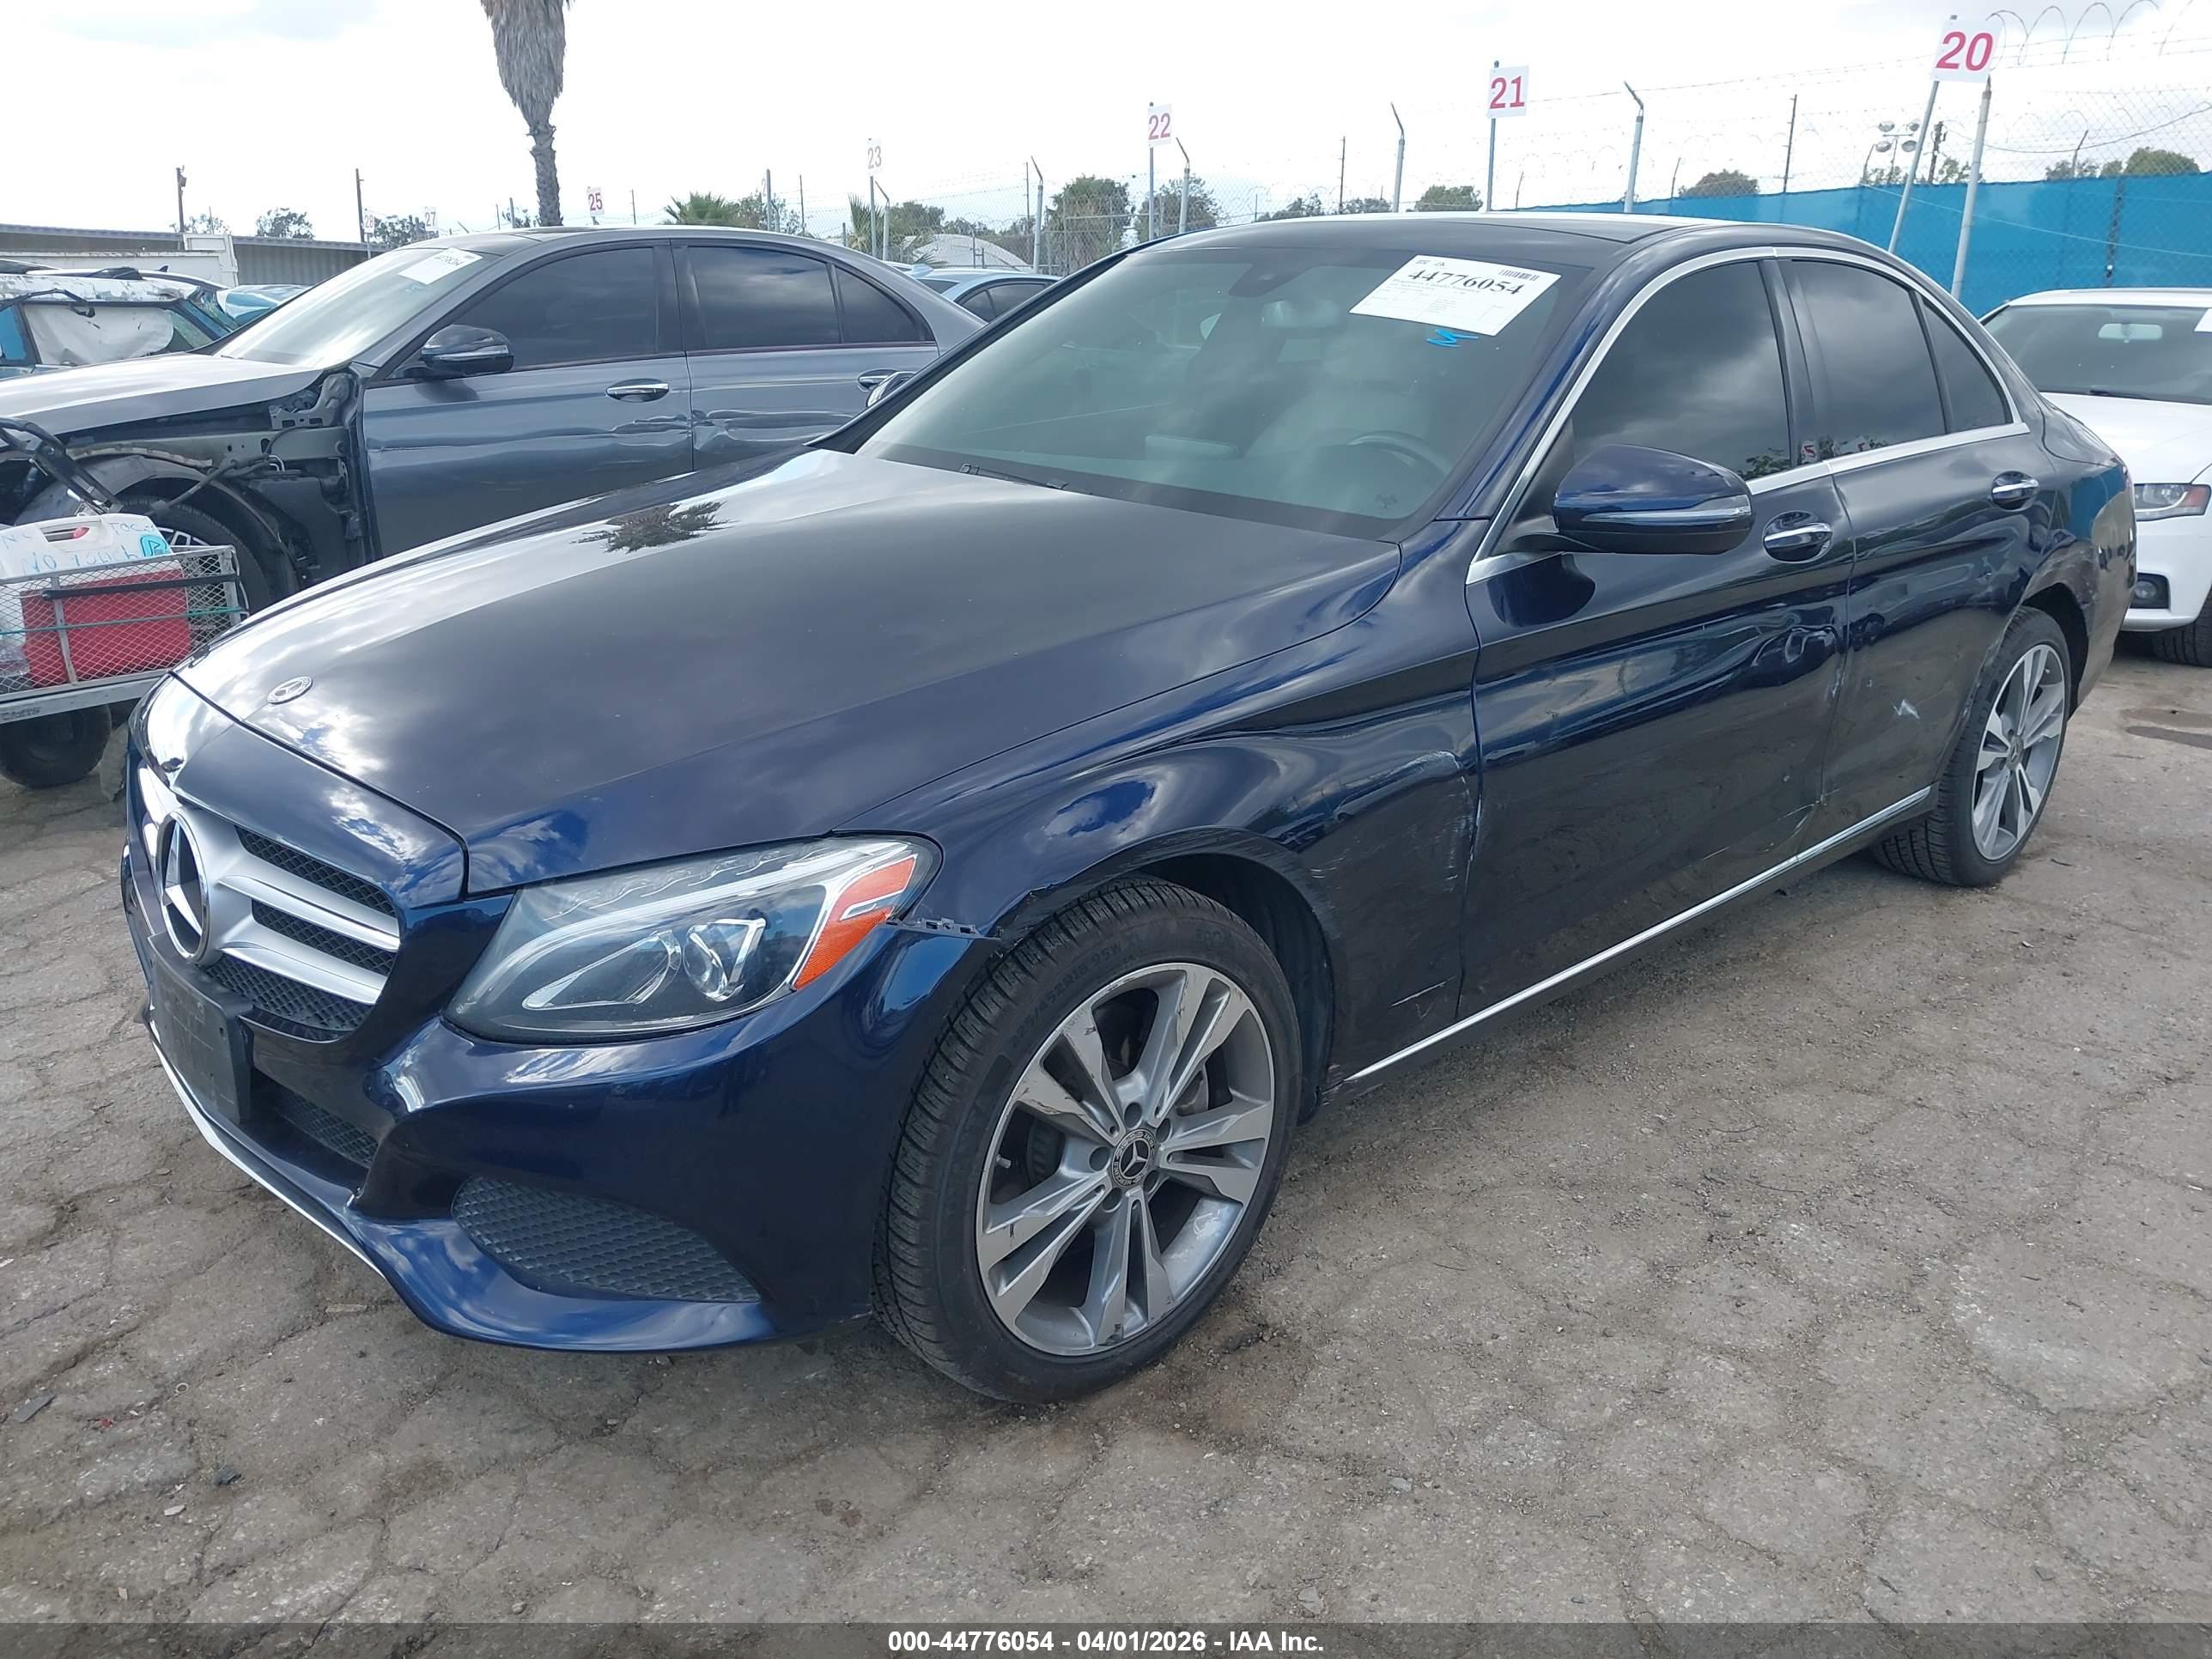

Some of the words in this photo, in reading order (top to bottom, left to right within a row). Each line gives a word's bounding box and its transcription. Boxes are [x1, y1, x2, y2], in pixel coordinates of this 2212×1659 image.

[1936, 31, 1993, 71] 20
[1490, 75, 1525, 109] 21
[1148, 112, 1170, 140] 22
[867, 145, 882, 169] 23
[588, 192, 603, 211] 25
[364, 214, 374, 228] 28
[424, 210, 437, 228] 27
[1407, 269, 1526, 295] 44776054
